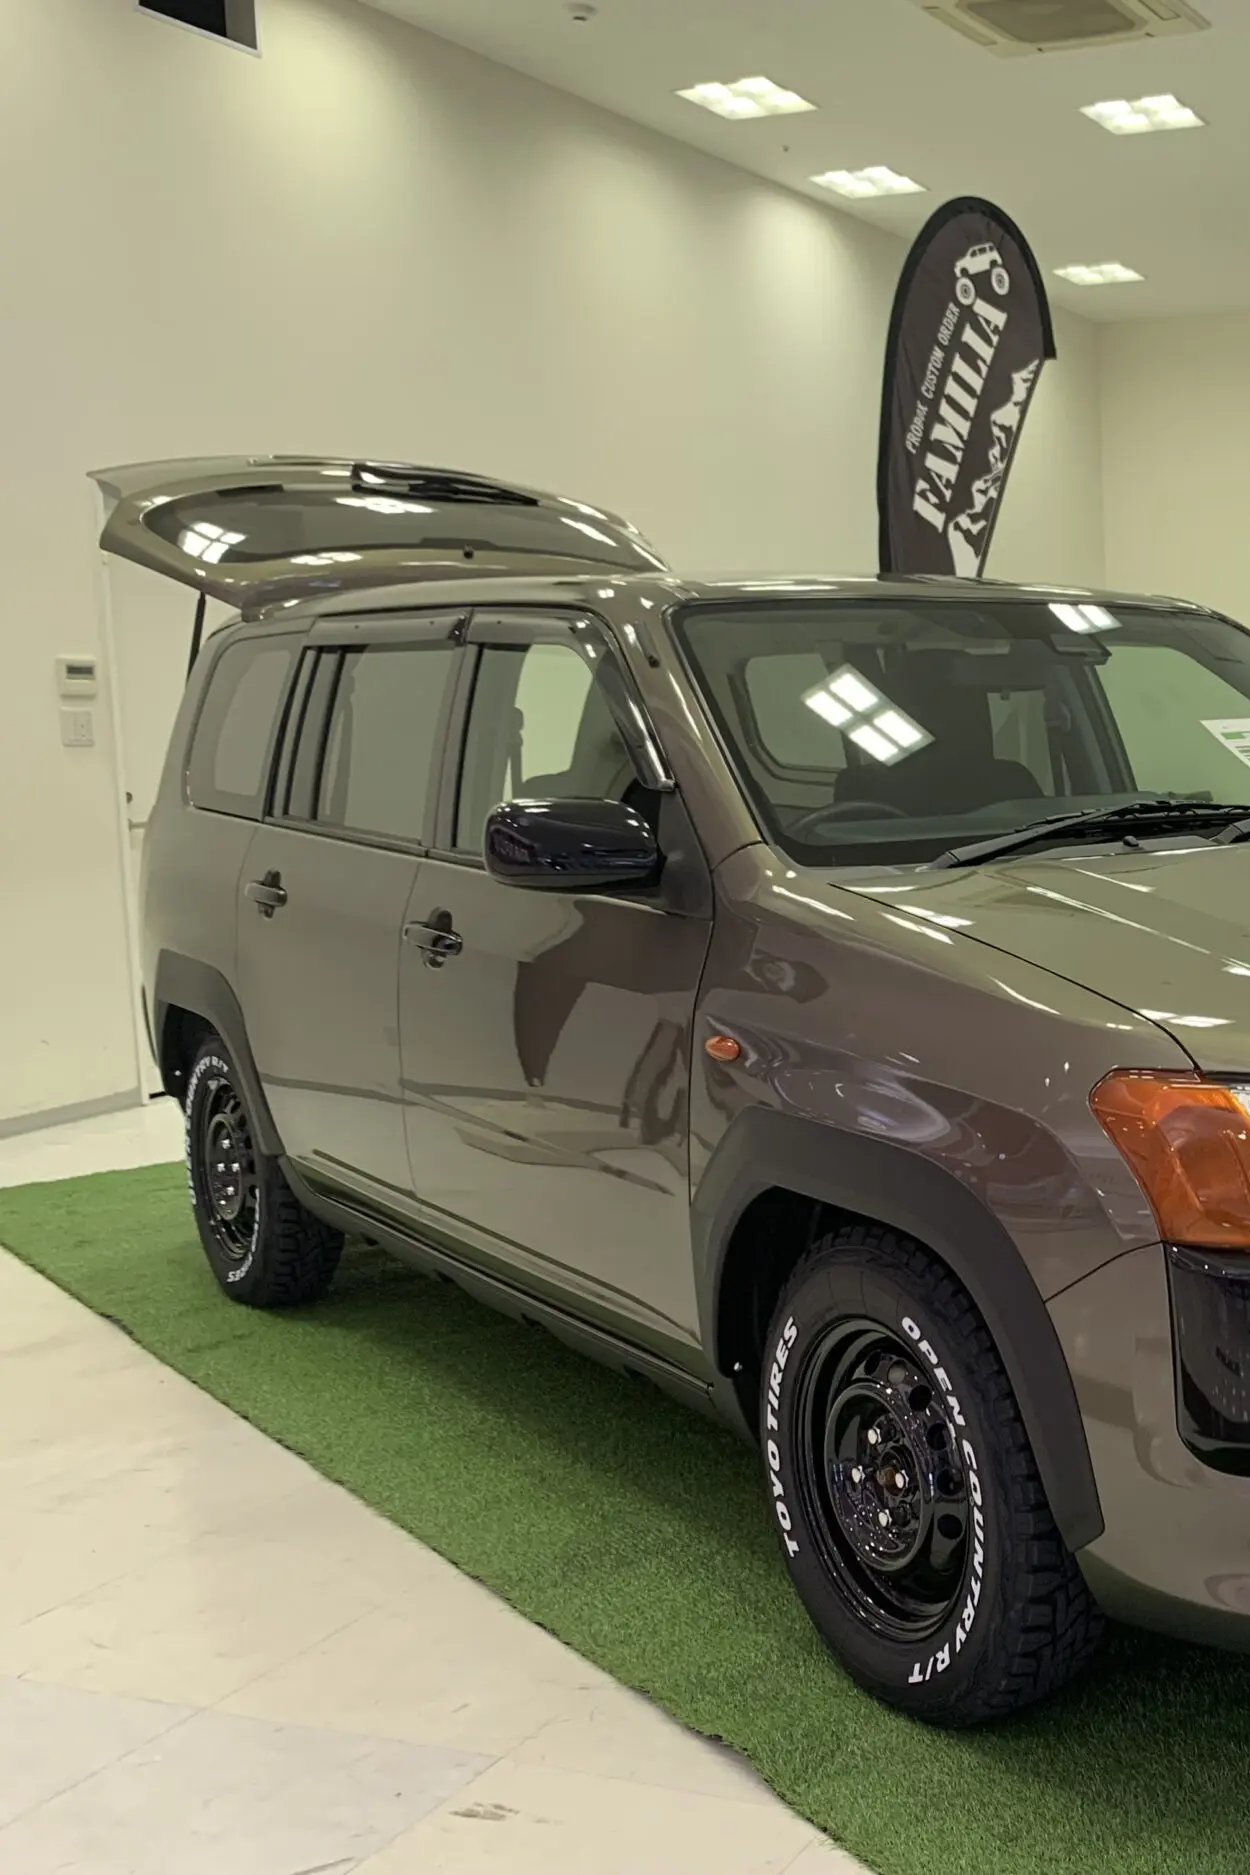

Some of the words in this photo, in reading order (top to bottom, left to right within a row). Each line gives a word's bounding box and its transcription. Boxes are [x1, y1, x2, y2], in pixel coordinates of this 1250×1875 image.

[904, 400, 930, 454] PROBOX
[920, 346, 945, 401] CUSTOM
[937, 302, 960, 347] ORDER
[912, 297, 1008, 533] FAMILIA
[767, 1316, 798, 1428] TIRES
[901, 1316, 966, 1427] OPEN
[767, 1438, 801, 1557] TOYO
[955, 1438, 986, 1653] COUNTRY
[908, 1642, 951, 1684] R/T
